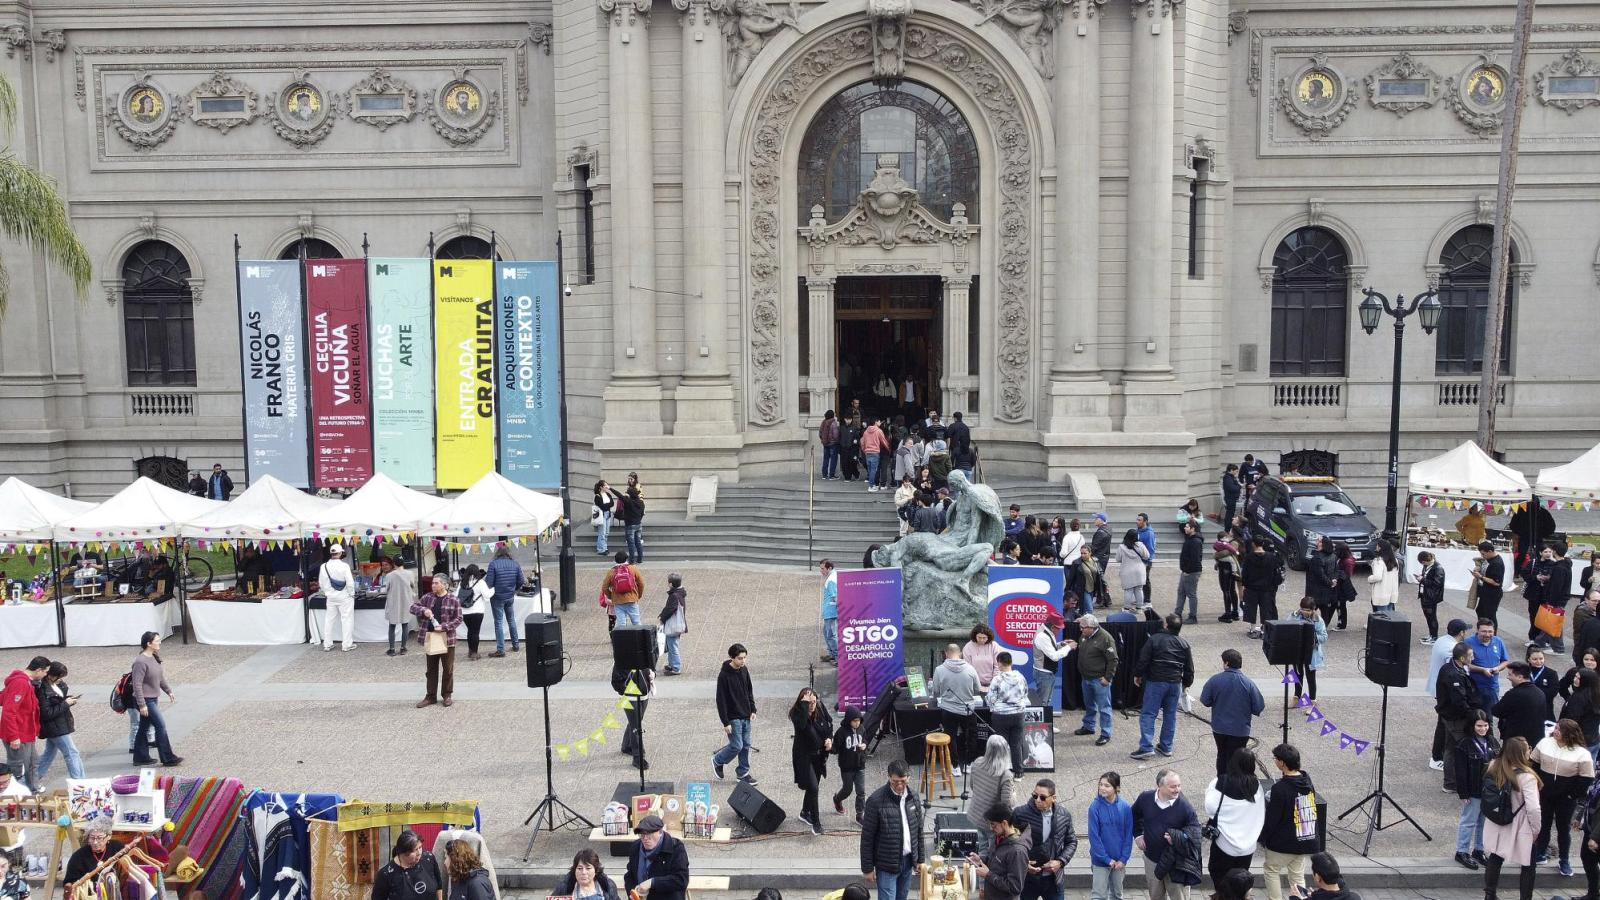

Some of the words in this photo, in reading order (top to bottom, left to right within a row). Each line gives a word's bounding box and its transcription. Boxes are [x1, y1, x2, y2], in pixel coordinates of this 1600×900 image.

[246, 311, 263, 379] NICOLÁS
[284, 334, 296, 361] GRIS
[315, 312, 329, 373] CECILIA
[351, 323, 360, 353] AGUA
[399, 325, 412, 366] ARTE
[504, 296, 516, 390] ADQUISICIONES
[518, 296, 533, 391] CONTEXTO
[265, 334, 282, 417] FRANCO
[329, 324, 351, 406] VICUÑA
[352, 355, 360, 366] EL
[377, 324, 393, 400] LUCHAS
[476, 300, 492, 418] GRATUITA
[286, 364, 297, 417] MATERIA
[352, 369, 362, 404] SOÑAR
[458, 338, 476, 431] ENTRADA
[525, 395, 535, 409] EN
[1006, 605, 1047, 613] CENTROS
[1006, 622, 1042, 630] SERCOTE
[842, 625, 898, 643] STGO
[845, 643, 895, 652] DESARROLLO
[847, 651, 893, 660] ECONÓMICO
